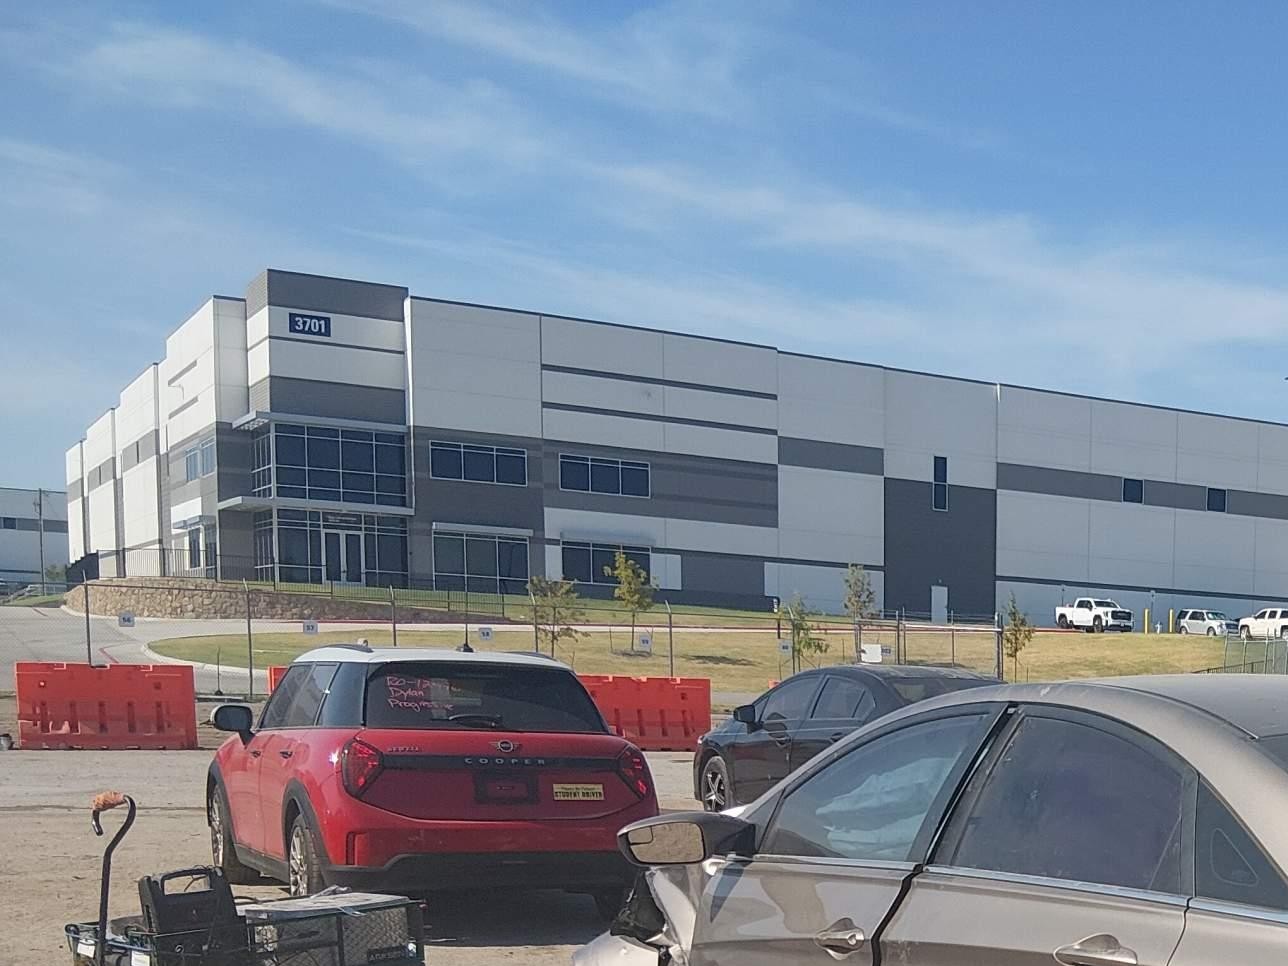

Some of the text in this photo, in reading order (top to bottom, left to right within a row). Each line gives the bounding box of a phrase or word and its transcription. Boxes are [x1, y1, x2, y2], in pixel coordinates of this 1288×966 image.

[295, 317, 326, 333] 3701
[389, 687, 424, 701] Dylan
[465, 757, 545, 765] COOPER
